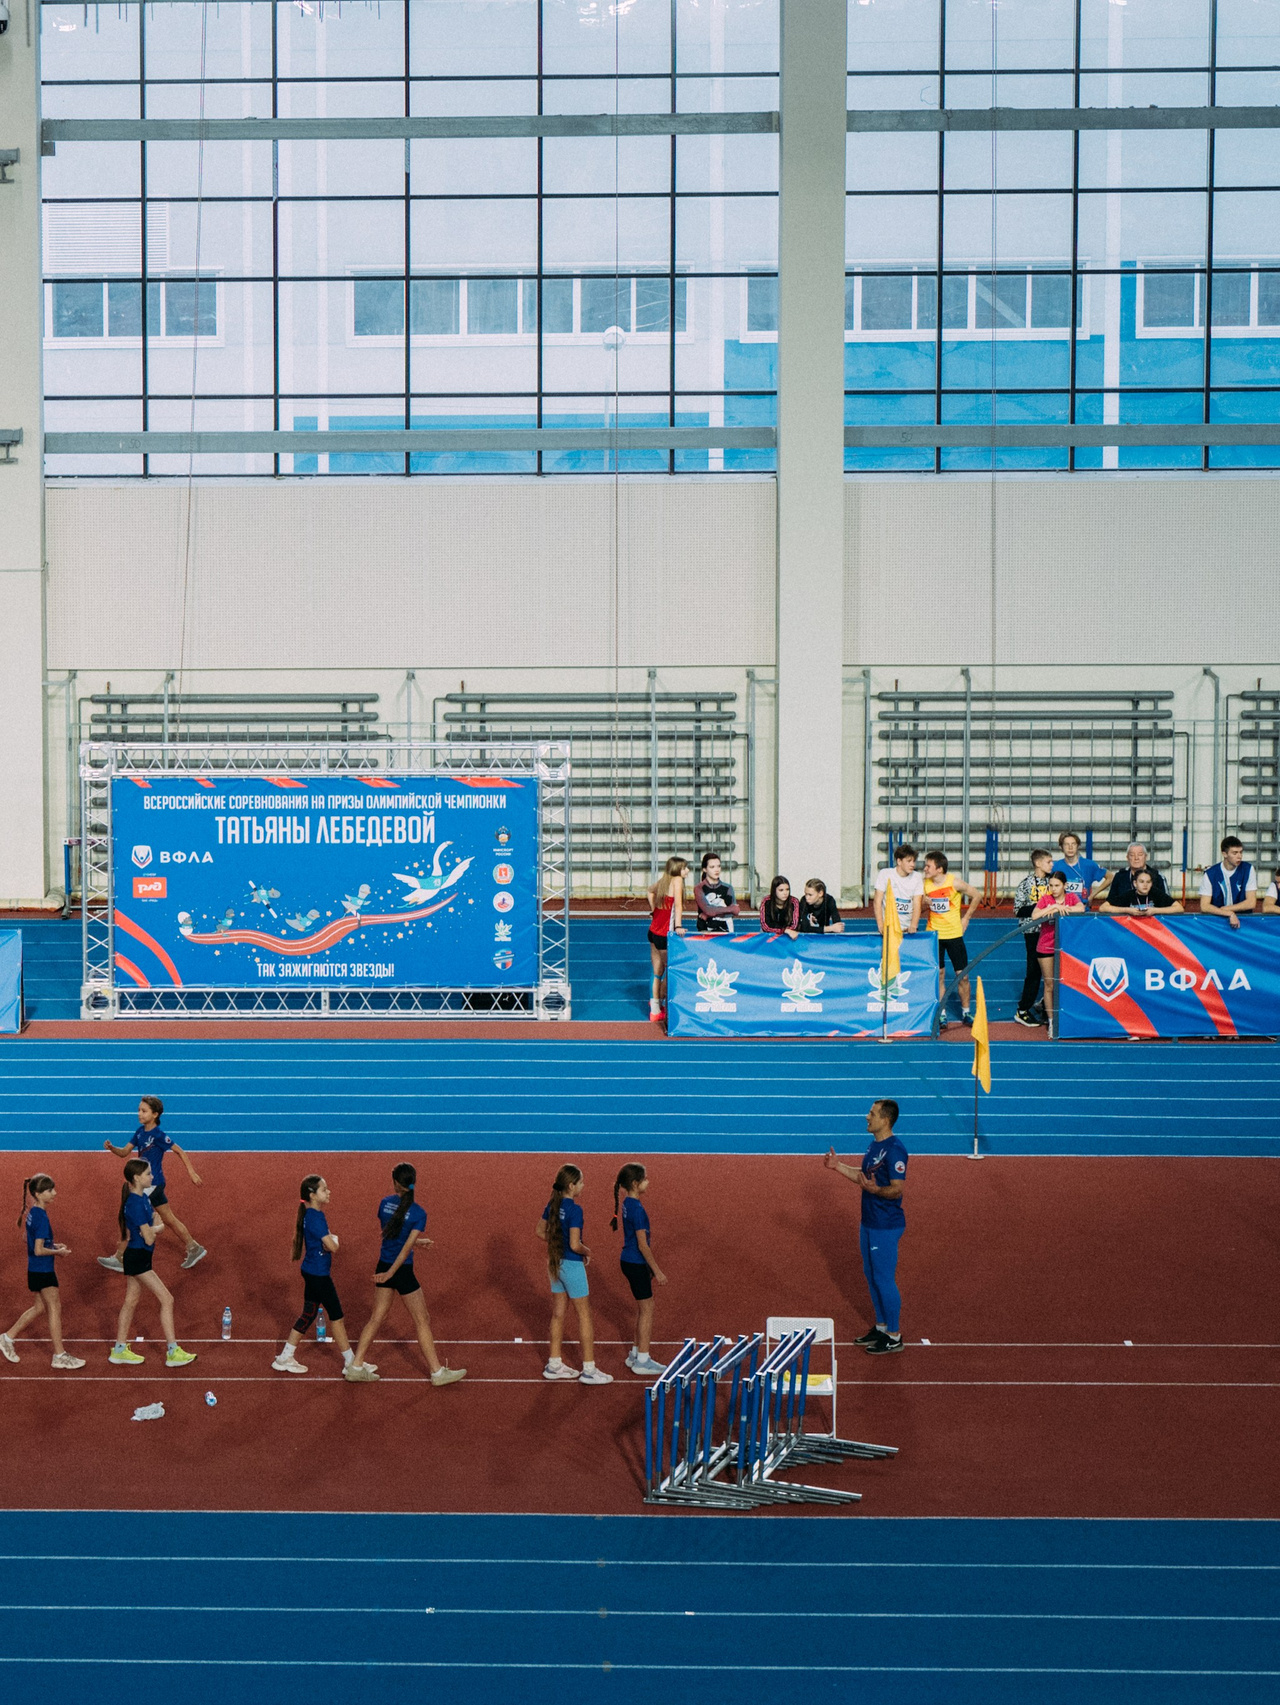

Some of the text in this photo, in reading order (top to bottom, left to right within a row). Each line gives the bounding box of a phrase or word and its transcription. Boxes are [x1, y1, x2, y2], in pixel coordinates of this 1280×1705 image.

[143, 792, 507, 810] ВСЕРОССИЙСКИЕ СОРЕВНОВАНИЯ НА ПРИЗЫ ОЛИМПИЙСКОЙ ЧЕМПИОНКИ
[215, 810, 435, 847] ТАТЬЯНЫ ЛЕБЕДЕВОЙ
[160, 850, 214, 864] ВФЛА
[931, 902, 946, 910] 186
[257, 963, 395, 978] ТАК ЗАЖИГАЮТСЯ ЗВЕЗДЫ!
[1144, 967, 1252, 992] ВФЛА
